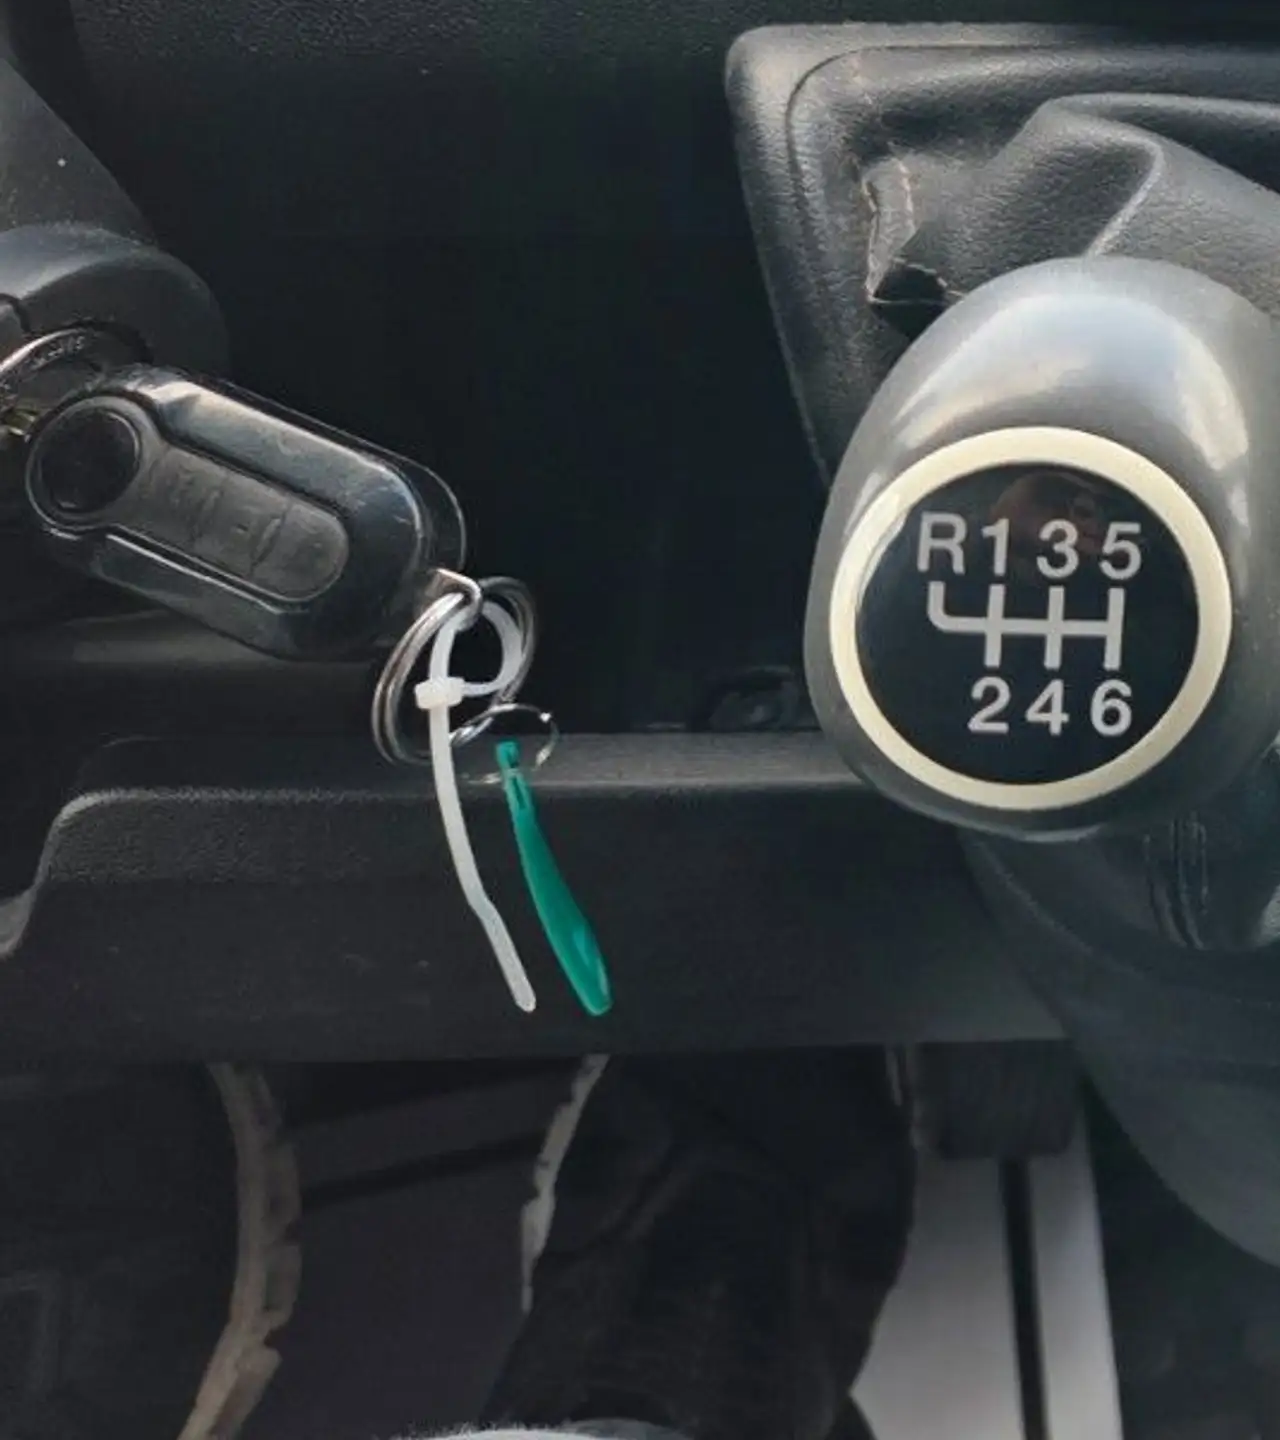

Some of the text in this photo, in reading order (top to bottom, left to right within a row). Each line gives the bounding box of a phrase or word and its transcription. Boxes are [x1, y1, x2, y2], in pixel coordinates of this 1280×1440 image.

[916, 511, 1142, 581] R 1 3 5
[966, 674, 1134, 738] 2 4 6
